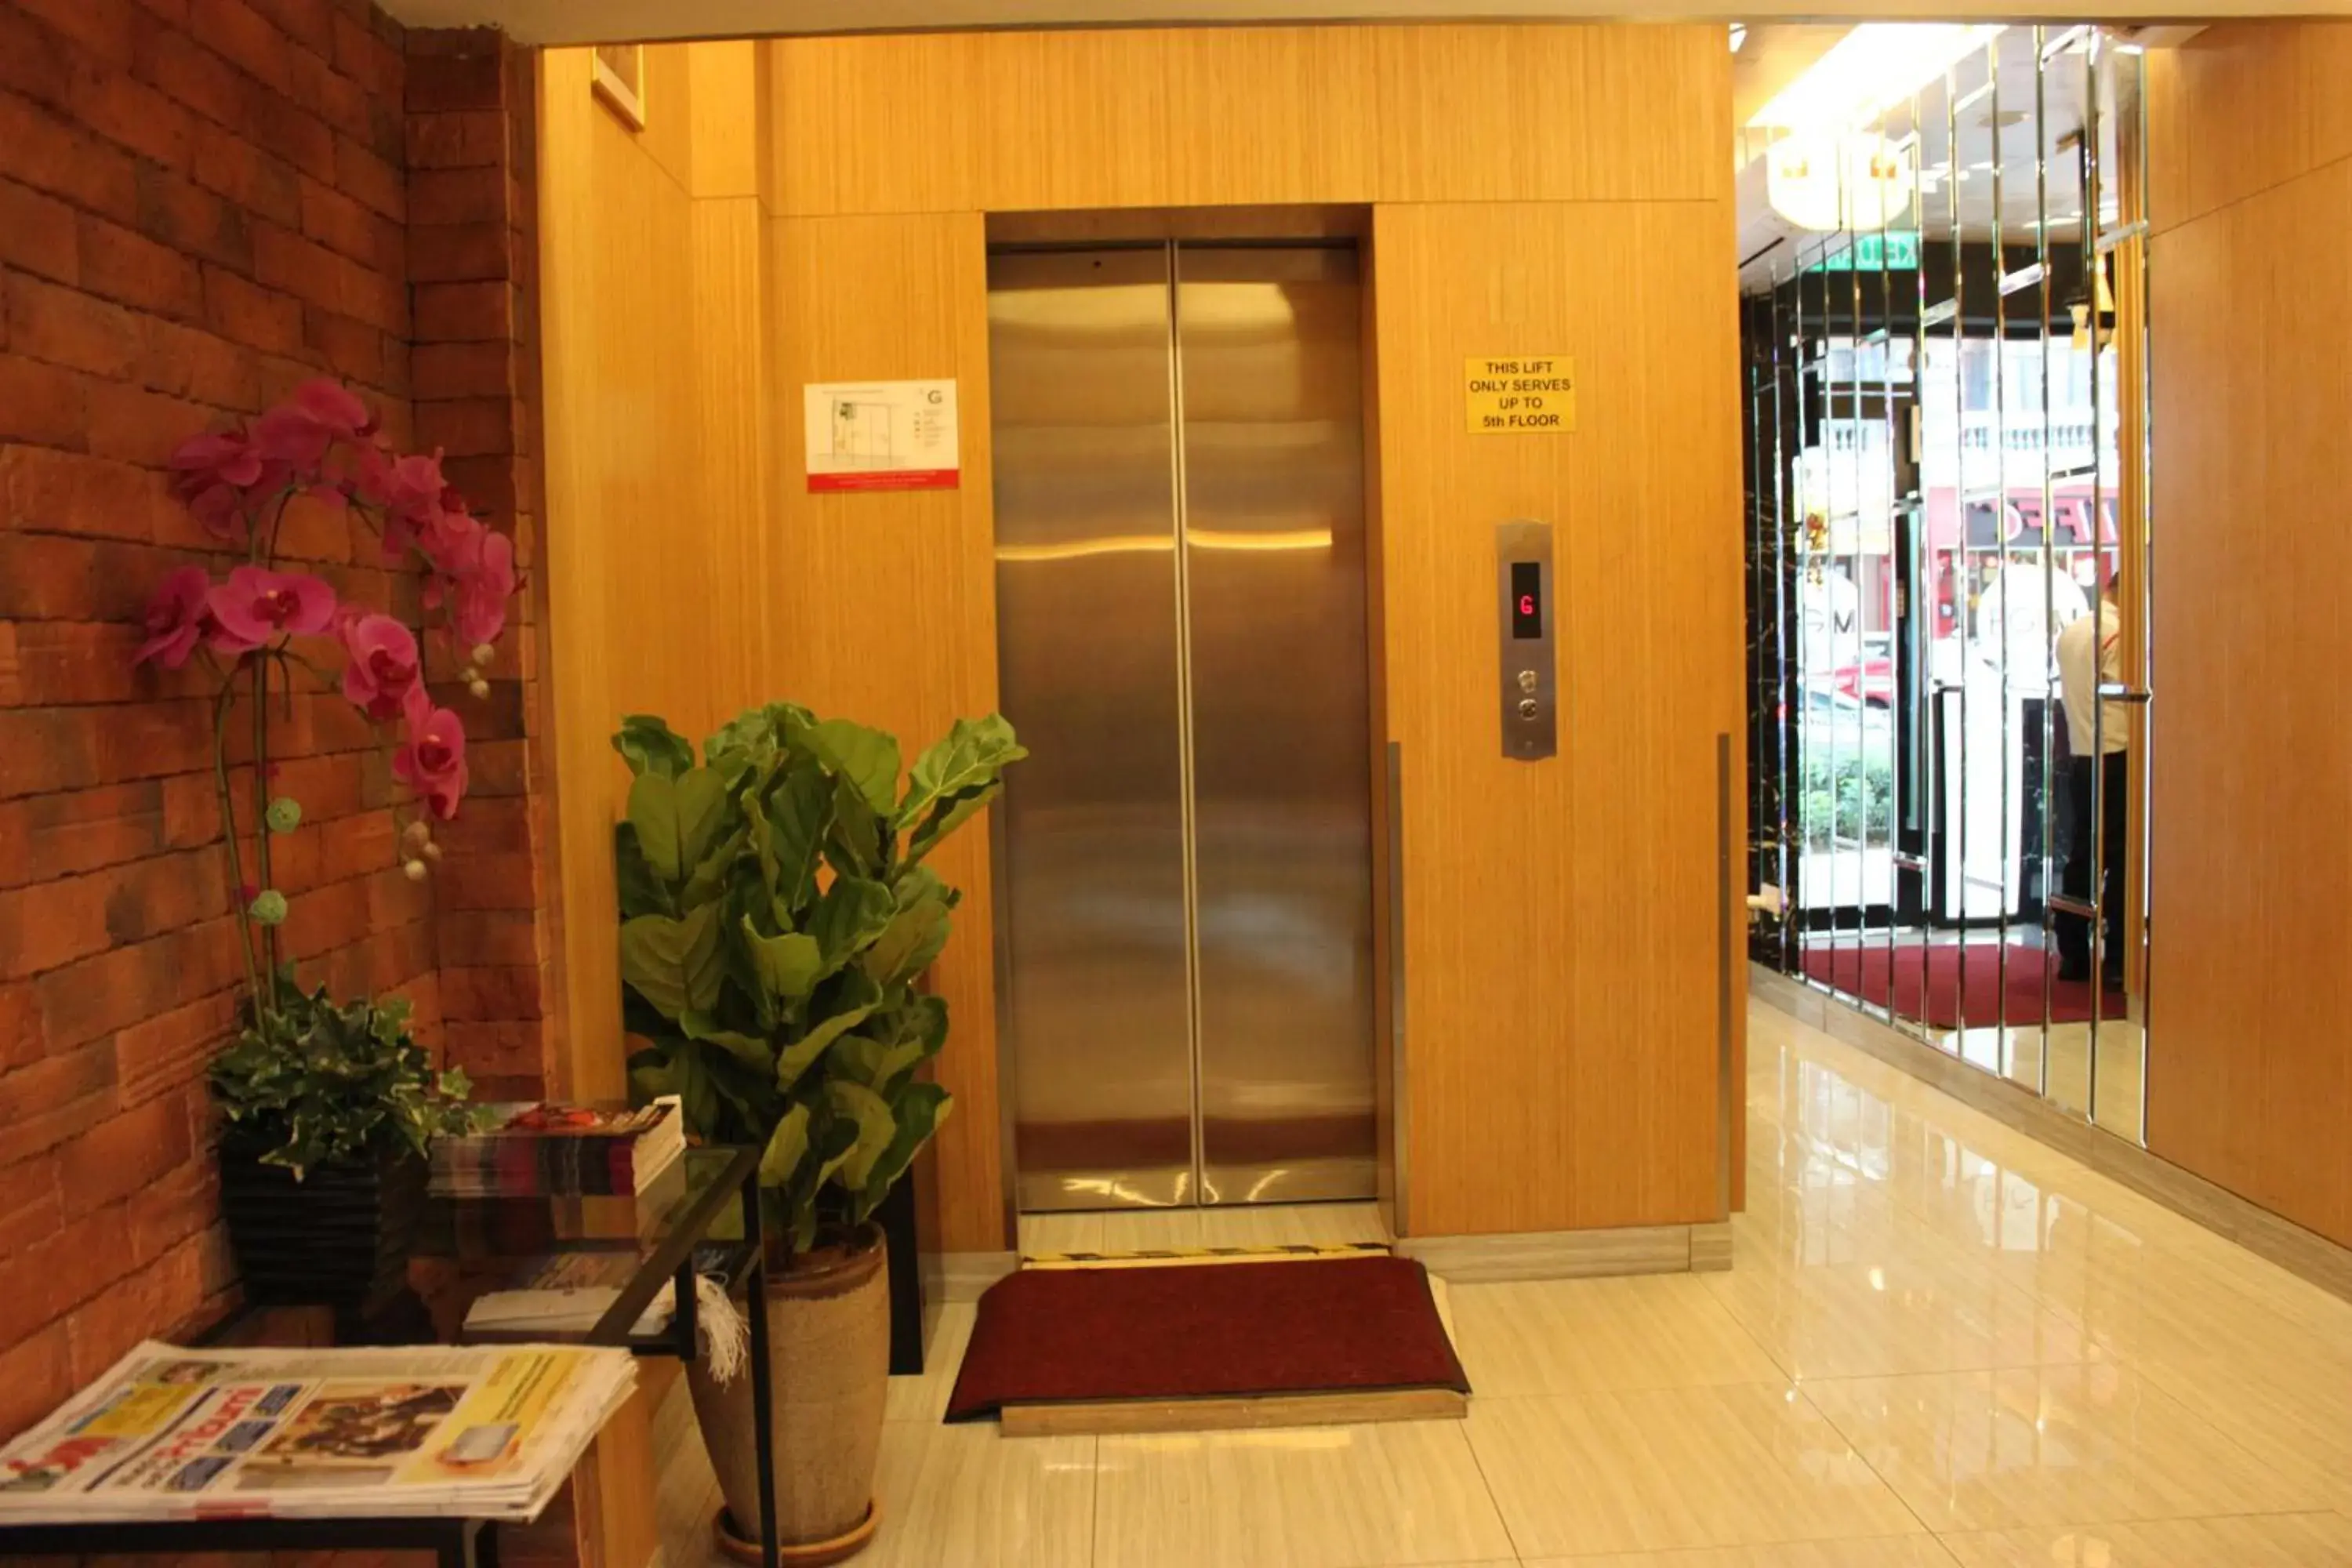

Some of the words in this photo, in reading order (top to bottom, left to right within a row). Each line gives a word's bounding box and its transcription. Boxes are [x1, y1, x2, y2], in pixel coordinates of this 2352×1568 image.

[1486, 361, 1519, 374] THIS
[1523, 361, 1553, 373] LIFT
[1469, 380, 1508, 393] ONLY
[1512, 379, 1571, 391] SERVES
[1499, 397, 1518, 409] UP
[1523, 397, 1543, 408] TO
[1483, 416, 1504, 427] 5th
[1509, 414, 1559, 427] FLOOR
